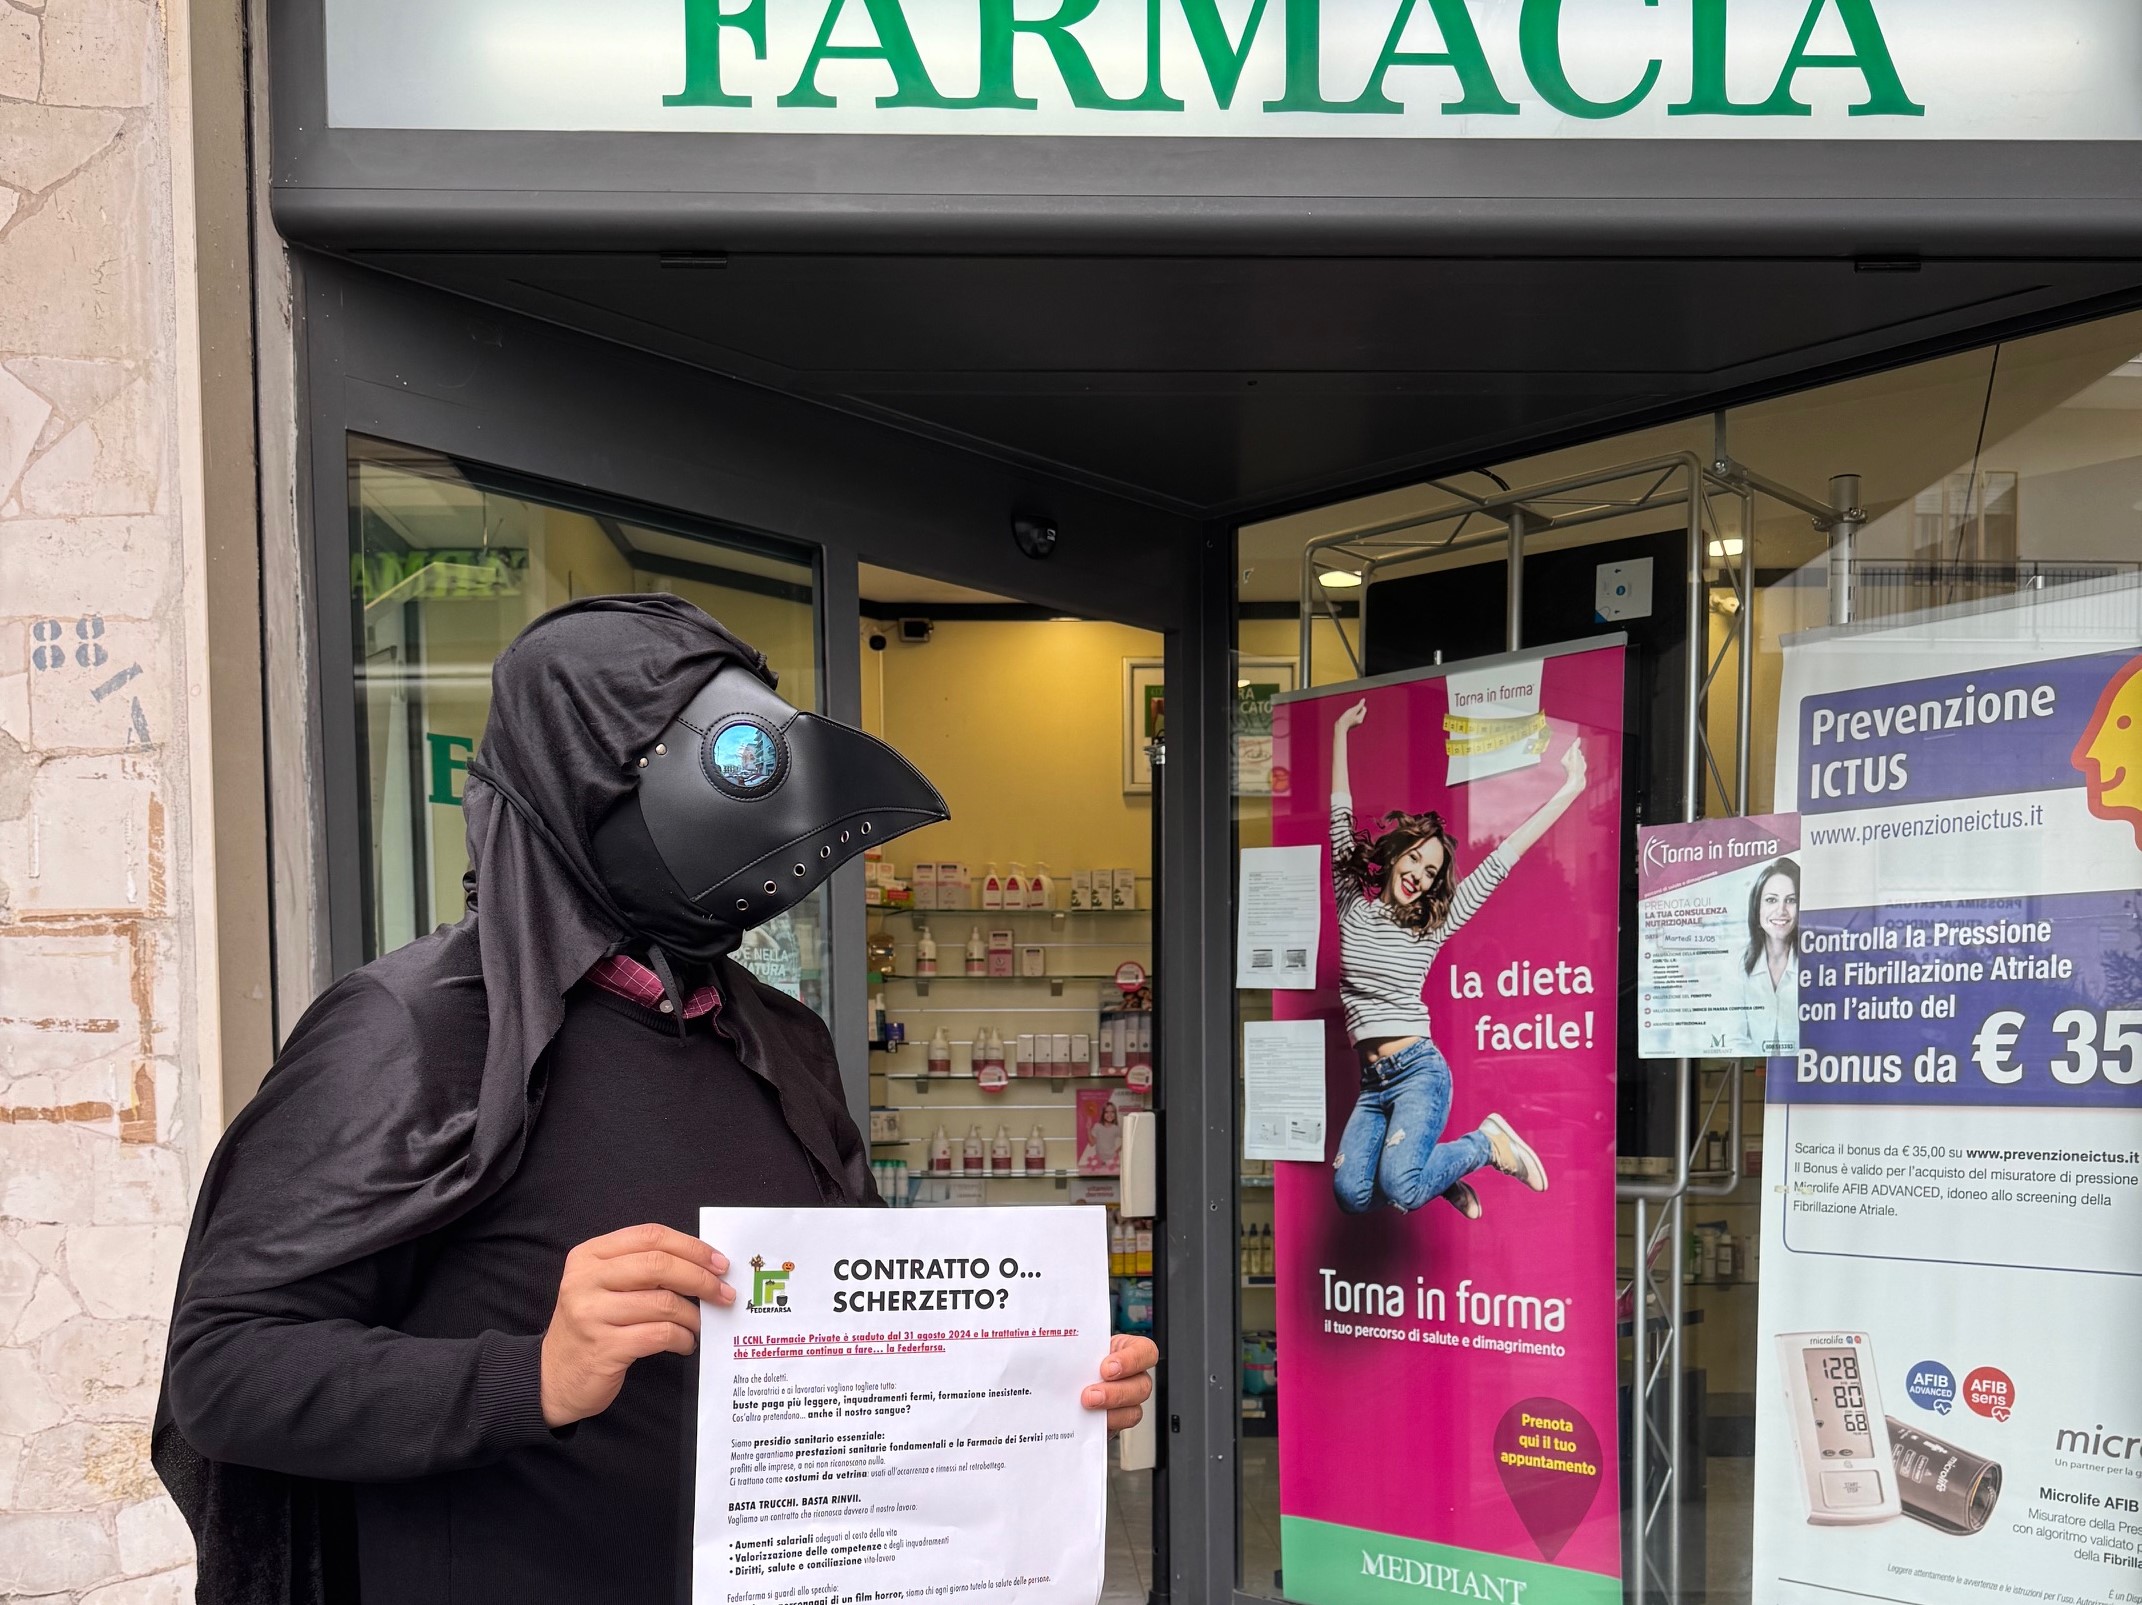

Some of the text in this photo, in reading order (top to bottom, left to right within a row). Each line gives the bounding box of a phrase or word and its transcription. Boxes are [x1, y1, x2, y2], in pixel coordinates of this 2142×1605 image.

[662, 0, 1926, 119] FARMACIA
[1454, 684, 1533, 707] Torna in forma
[1812, 684, 2056, 745] Prevenzione
[1810, 753, 1907, 799] ICTUS
[1810, 805, 2044, 846] www.prevenzioneictus.it
[1661, 843, 1704, 864] Torna
[1709, 840, 1723, 859] in
[1644, 897, 1711, 911] PRENOTA QUI
[1645, 907, 1728, 919] LA TUA CONSULENZA
[1801, 920, 2052, 952] Controlla la Pressione
[754, 948, 789, 962] NELLA
[1451, 961, 1594, 998] la dieta
[1800, 953, 2073, 987] e la Fibrillazione Atriale
[1798, 994, 1955, 1021] con l'aiuto del
[1475, 1011, 1595, 1051] facile!
[1798, 1009, 2142, 1085] Bonus da € 35
[1795, 1142, 2140, 1163] Scarica il bonus da € 35,00 su www.prevenzioneictus.it
[1794, 1161, 2139, 1185] Il Bonus è valido per l'acquisto del misuratore di pressione
[1842, 1182, 1869, 1195] AFIB
[1871, 1184, 1943, 1199] ADVANCED,
[1947, 1187, 1988, 1200] idoneo
[1991, 1189, 2013, 1201] allo
[2016, 1192, 2077, 1207] screening
[2081, 1193, 2112, 1206] della
[1793, 1200, 1898, 1216] Fibrillazione Atriale.
[833, 1257, 1041, 1281] CONTRATTO O...
[833, 1289, 1009, 1313] SCHERZETTO?
[1319, 1269, 1404, 1316] Torna
[1417, 1277, 1445, 1320] in
[734, 1335, 740, 1347] Il
[743, 1335, 764, 1347] CCNL
[766, 1334, 806, 1346] Farmacie
[809, 1333, 841, 1344] Private
[843, 1332, 849, 1344] è
[852, 1331, 885, 1343] scaduto
[887, 1331, 901, 1342] dal
[904, 1331, 914, 1342] 31
[917, 1331, 946, 1341] agosto
[949, 1329, 971, 1340] 2024
[973, 1331, 979, 1340] e
[981, 1328, 989, 1340] la
[992, 1328, 1029, 1339] trattativa
[1032, 1328, 1037, 1338] è
[1039, 1327, 1062, 1338] ferma
[1324, 1319, 1565, 1356] il tuo percorso di salute e dimagrimento
[1809, 1335, 1844, 1345] microlife
[734, 1342, 946, 1360] ché Federfarma continua a fare... la Federfarsa.
[1823, 1357, 1858, 1380] 128
[1912, 1373, 1948, 1387] AFIB
[1833, 1385, 1863, 1409] 80
[1909, 1386, 1953, 1398] ADVANCED
[1971, 1379, 2007, 1394] AFIB
[733, 1388, 1032, 1410] buste paga più leggere, inquadramenti fermi, formazione inesistente.
[1971, 1393, 2006, 1406] sens
[1522, 1413, 1573, 1432] Prenota
[1844, 1413, 1868, 1432] 68
[754, 1436, 791, 1448] presidio
[794, 1434, 834, 1444] sanitario
[837, 1431, 885, 1442] essenziale:
[1519, 1434, 1577, 1452] qui il tuo
[2056, 1423, 2142, 1459] micr
[1501, 1452, 1596, 1475] appuntamento
[2055, 1458, 2133, 1476] Un partner per la
[728, 1494, 861, 1512] BASTA TRUCCHI. BASTA RINVII.
[2040, 1487, 2139, 1512] Microlife AFIB
[2029, 1508, 2086, 1526] Misuratore
[2089, 1517, 2115, 1531] della
[2013, 1523, 2134, 1551] con algoritmo validato
[2075, 1548, 2100, 1562] della
